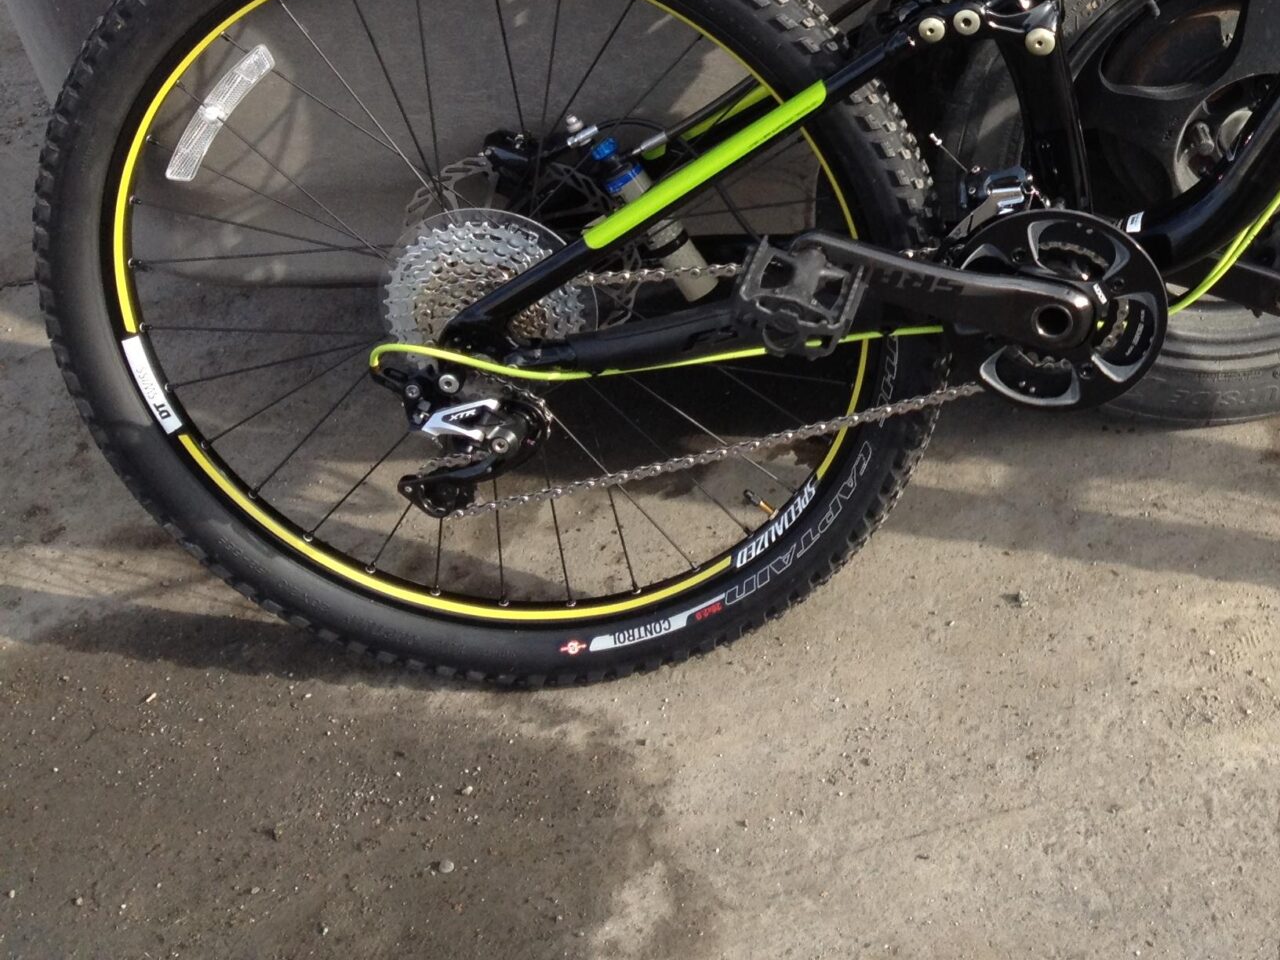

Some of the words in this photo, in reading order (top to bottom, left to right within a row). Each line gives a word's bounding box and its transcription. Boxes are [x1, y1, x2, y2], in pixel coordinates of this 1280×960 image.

[153, 402, 172, 421] DT
[448, 408, 477, 422] XTR
[735, 480, 817, 569] SPECIALIZED
[612, 617, 672, 646] CONTROL
